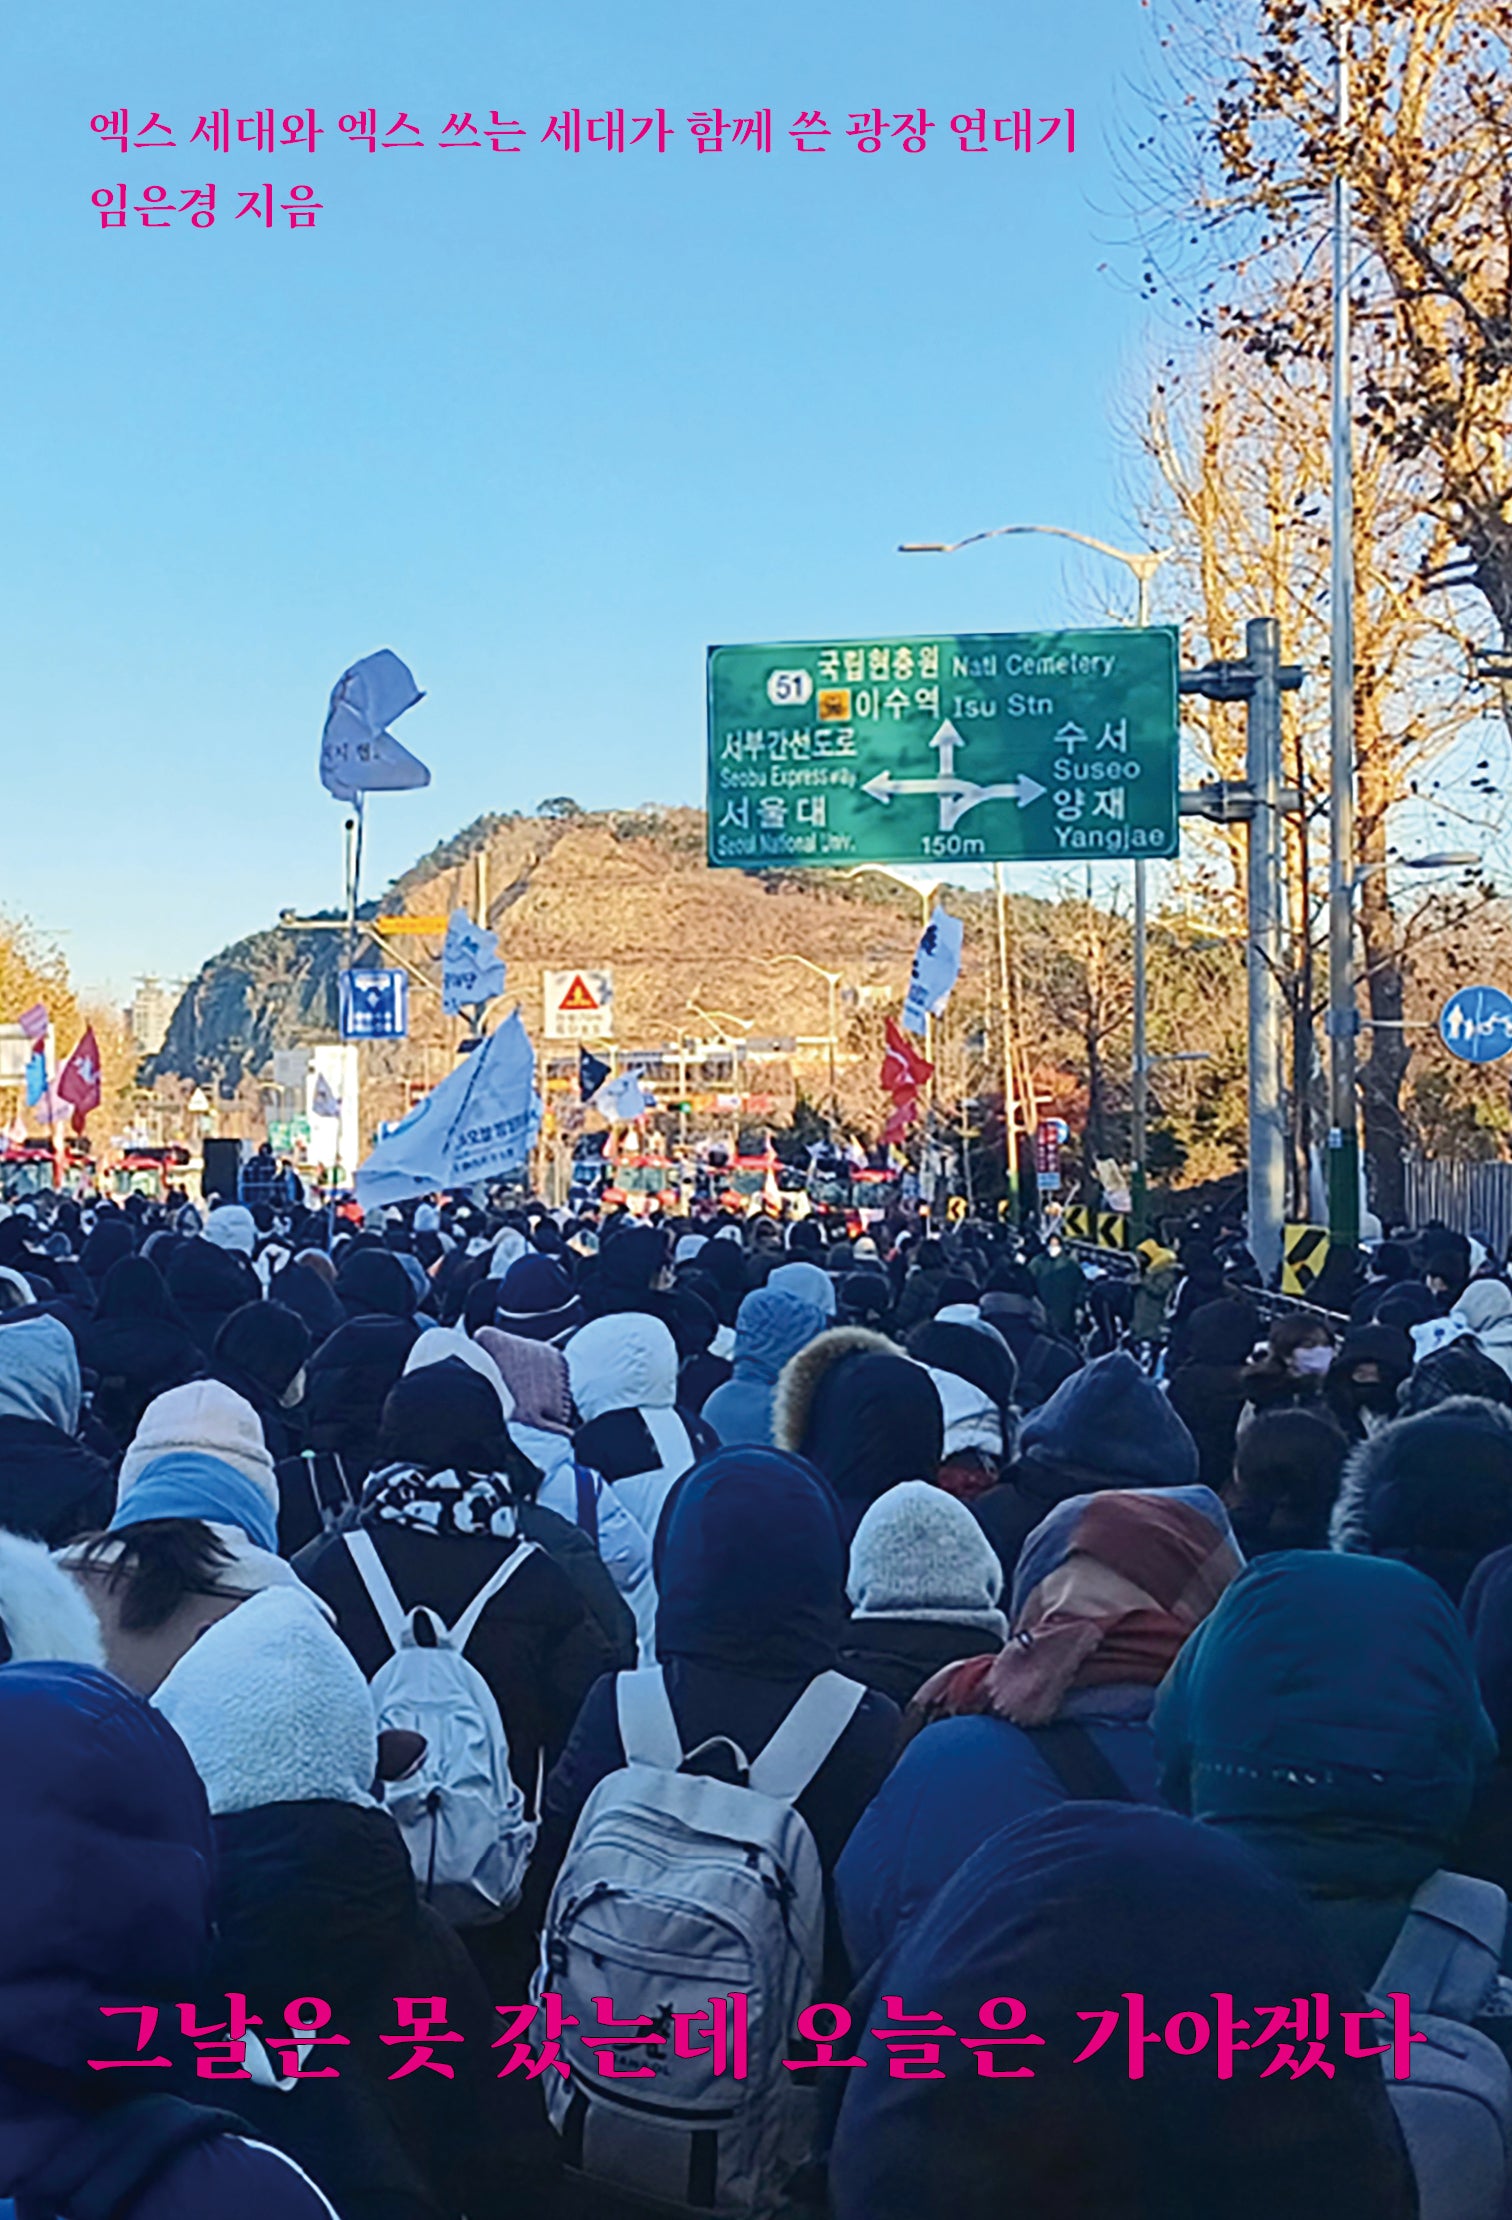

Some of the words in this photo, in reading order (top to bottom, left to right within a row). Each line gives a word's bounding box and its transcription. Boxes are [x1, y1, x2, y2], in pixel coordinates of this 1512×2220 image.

[817, 644, 939, 682] 국립현충원
[1005, 652, 1115, 677] Cemetery
[775, 674, 804, 700] 51
[855, 685, 939, 720] 이수역
[953, 696, 997, 718] Isu
[1007, 692, 1053, 717] Stn
[720, 727, 857, 762] 서부간선도로
[1054, 717, 1127, 755] 수서
[1053, 758, 1141, 781] Suseo
[718, 794, 826, 829] 서울대
[1053, 785, 1125, 821] 양재
[922, 835, 985, 855] 150m
[1054, 824, 1165, 852] Yangjae
